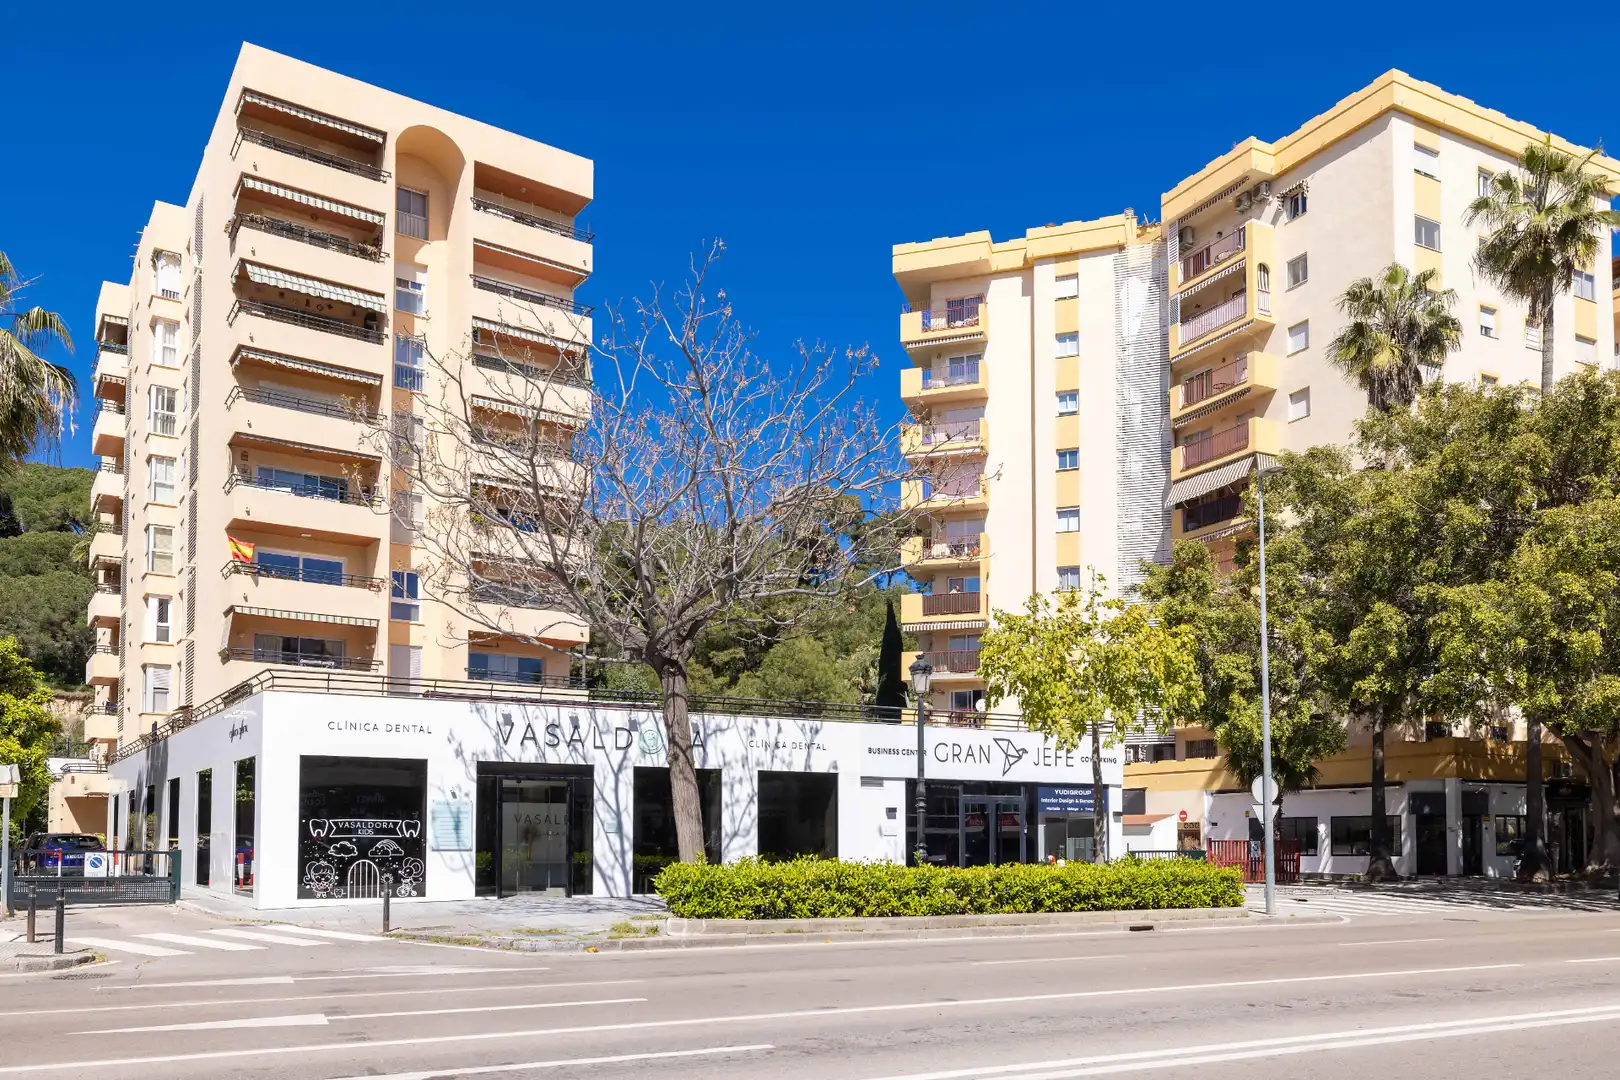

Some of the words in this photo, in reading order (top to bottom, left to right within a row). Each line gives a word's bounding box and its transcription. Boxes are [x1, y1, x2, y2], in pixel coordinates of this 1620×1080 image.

[328, 720, 379, 732] CLÍNICA
[385, 723, 432, 734] DENTAL
[497, 721, 705, 754] VASALDOA
[748, 739, 787, 749] CLÍNICA
[792, 742, 826, 750] DENTAL
[868, 747, 900, 756] BUSINESS
[934, 742, 990, 764] GRAN
[1033, 747, 1074, 767] JEFE
